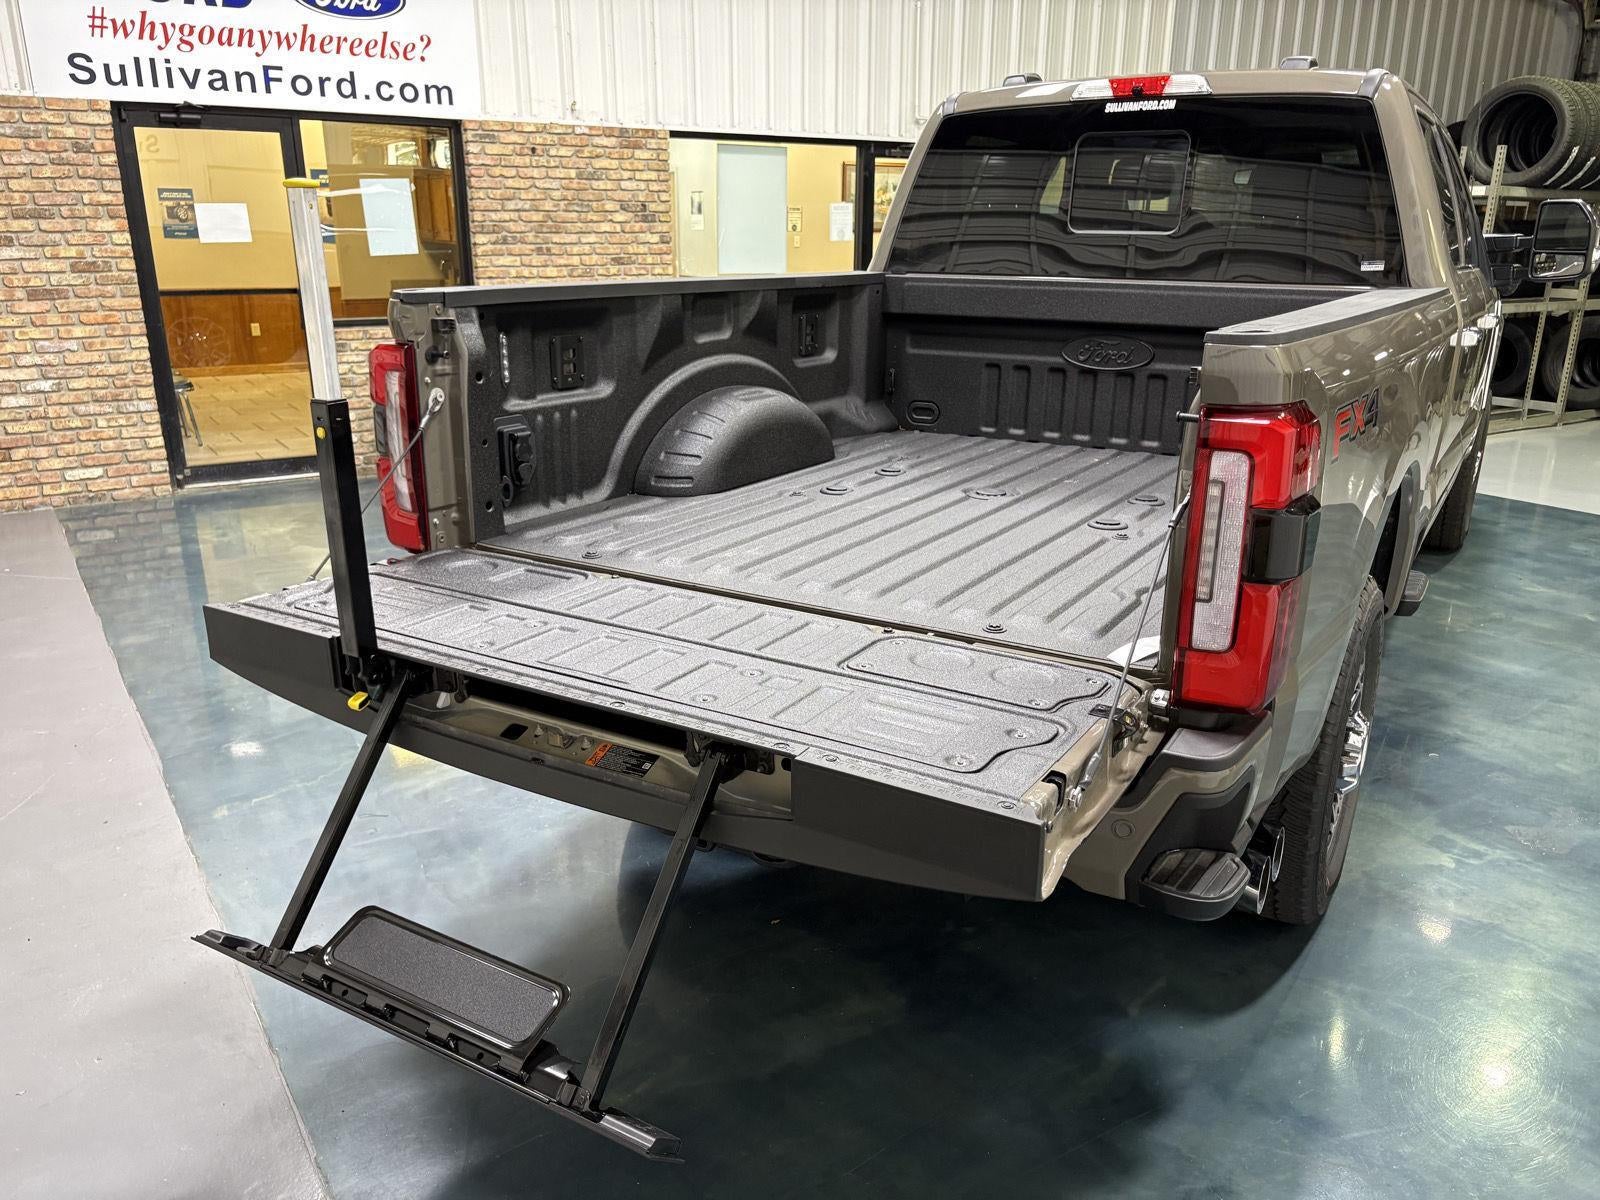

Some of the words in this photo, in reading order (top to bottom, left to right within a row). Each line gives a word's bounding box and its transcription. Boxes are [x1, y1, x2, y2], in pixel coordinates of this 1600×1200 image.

[87, 6, 432, 63] #whygoanywhereelse?
[67, 52, 455, 106] SullivanFord.com
[1104, 99, 1177, 113] SULLIVANFORD.COM
[1078, 341, 1134, 363] Ford
[1331, 386, 1379, 464] FX4
